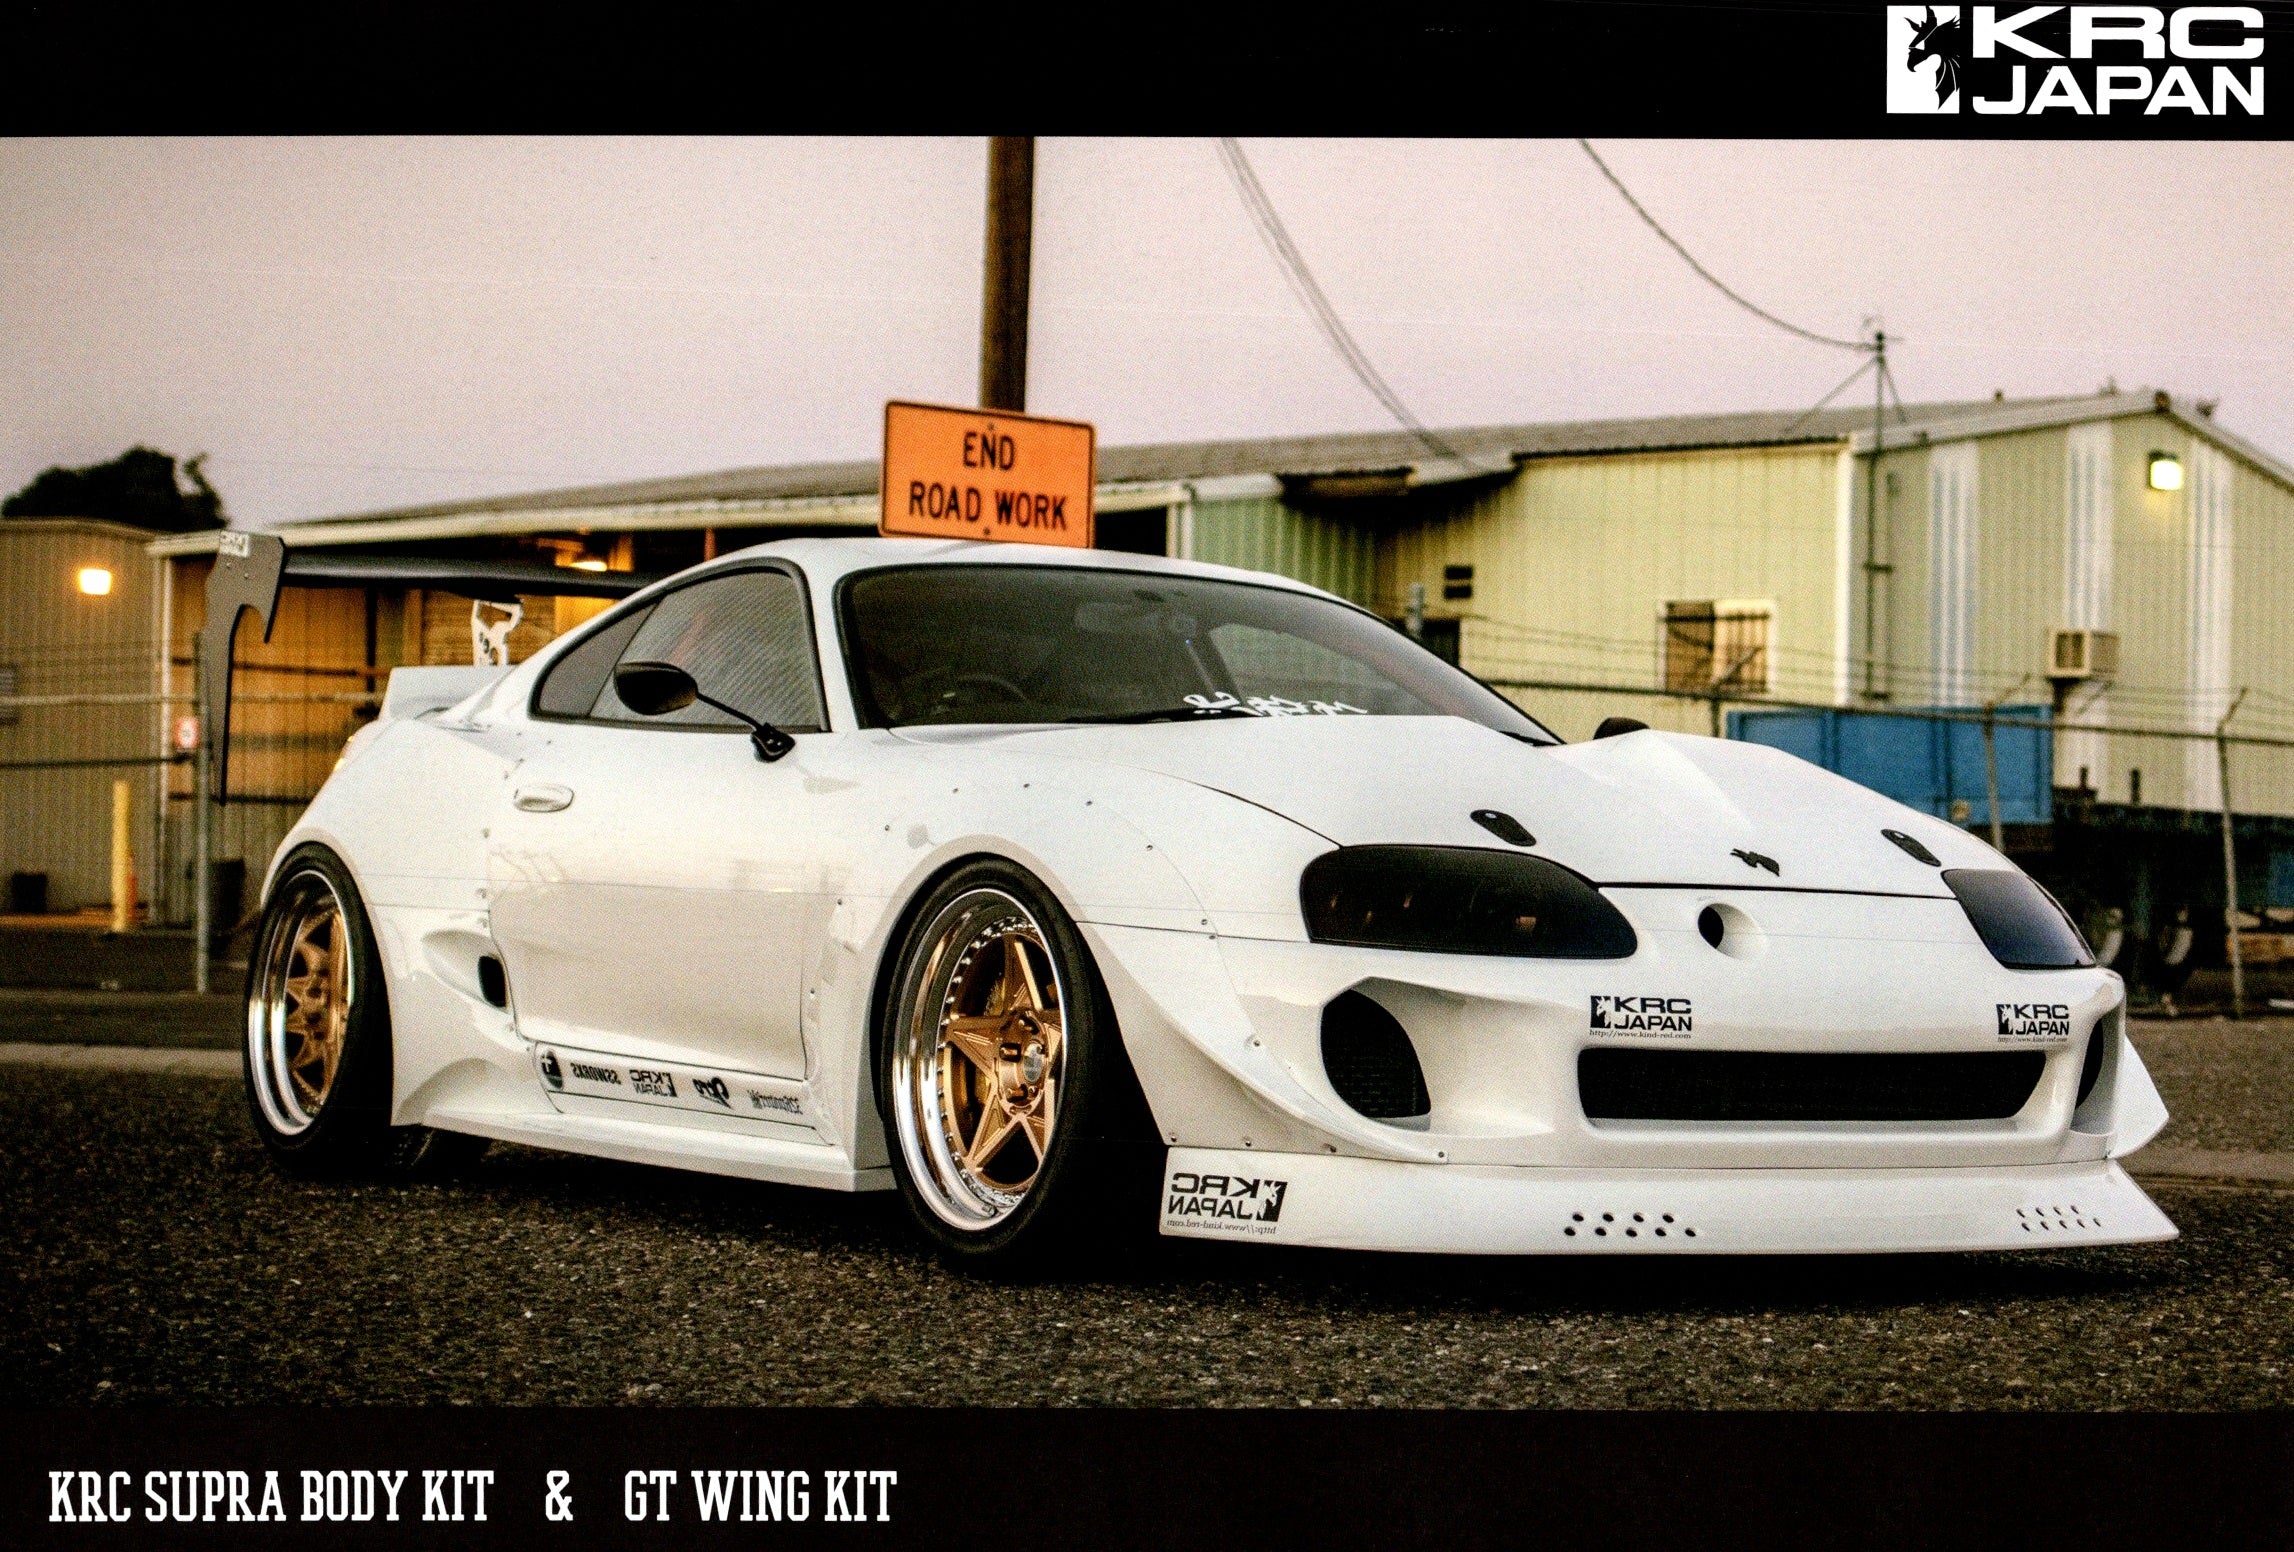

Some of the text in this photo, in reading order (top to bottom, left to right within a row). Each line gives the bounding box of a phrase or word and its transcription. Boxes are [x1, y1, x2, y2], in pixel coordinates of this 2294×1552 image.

[962, 430, 1016, 471] END
[908, 480, 1067, 531] ROAD WORK
[1613, 996, 1692, 1014] KRC
[2013, 1004, 2069, 1019] KRC
[1613, 1014, 1692, 1032] JAPAN
[2015, 1020, 2070, 1035] JAPAN
